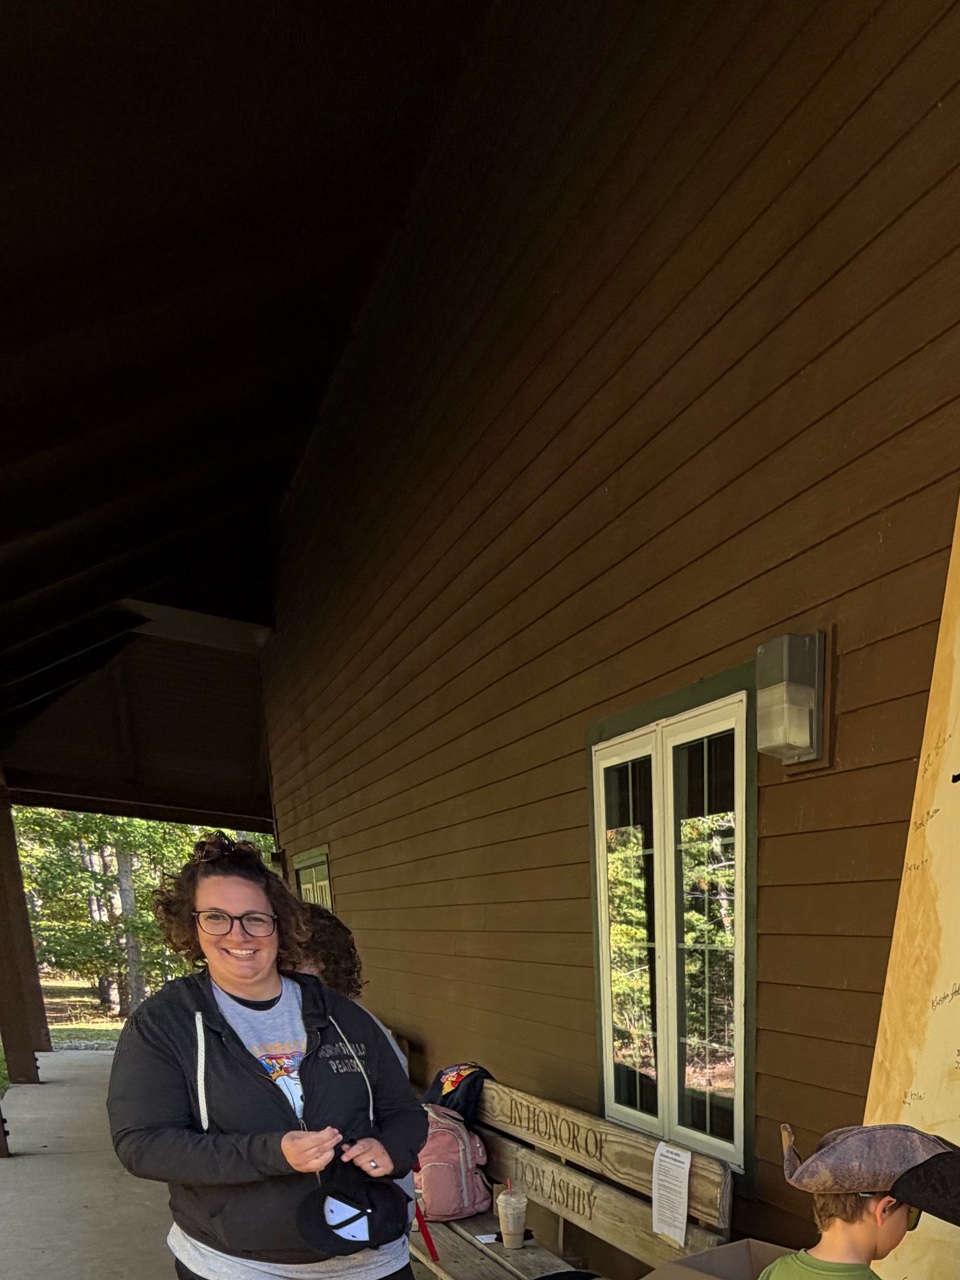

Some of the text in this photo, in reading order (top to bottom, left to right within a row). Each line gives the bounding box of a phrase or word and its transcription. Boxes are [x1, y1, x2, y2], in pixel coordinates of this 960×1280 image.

[509, 1098, 608, 1161] IN HONOR OF
[514, 1157, 598, 1221] DON ASHBY
